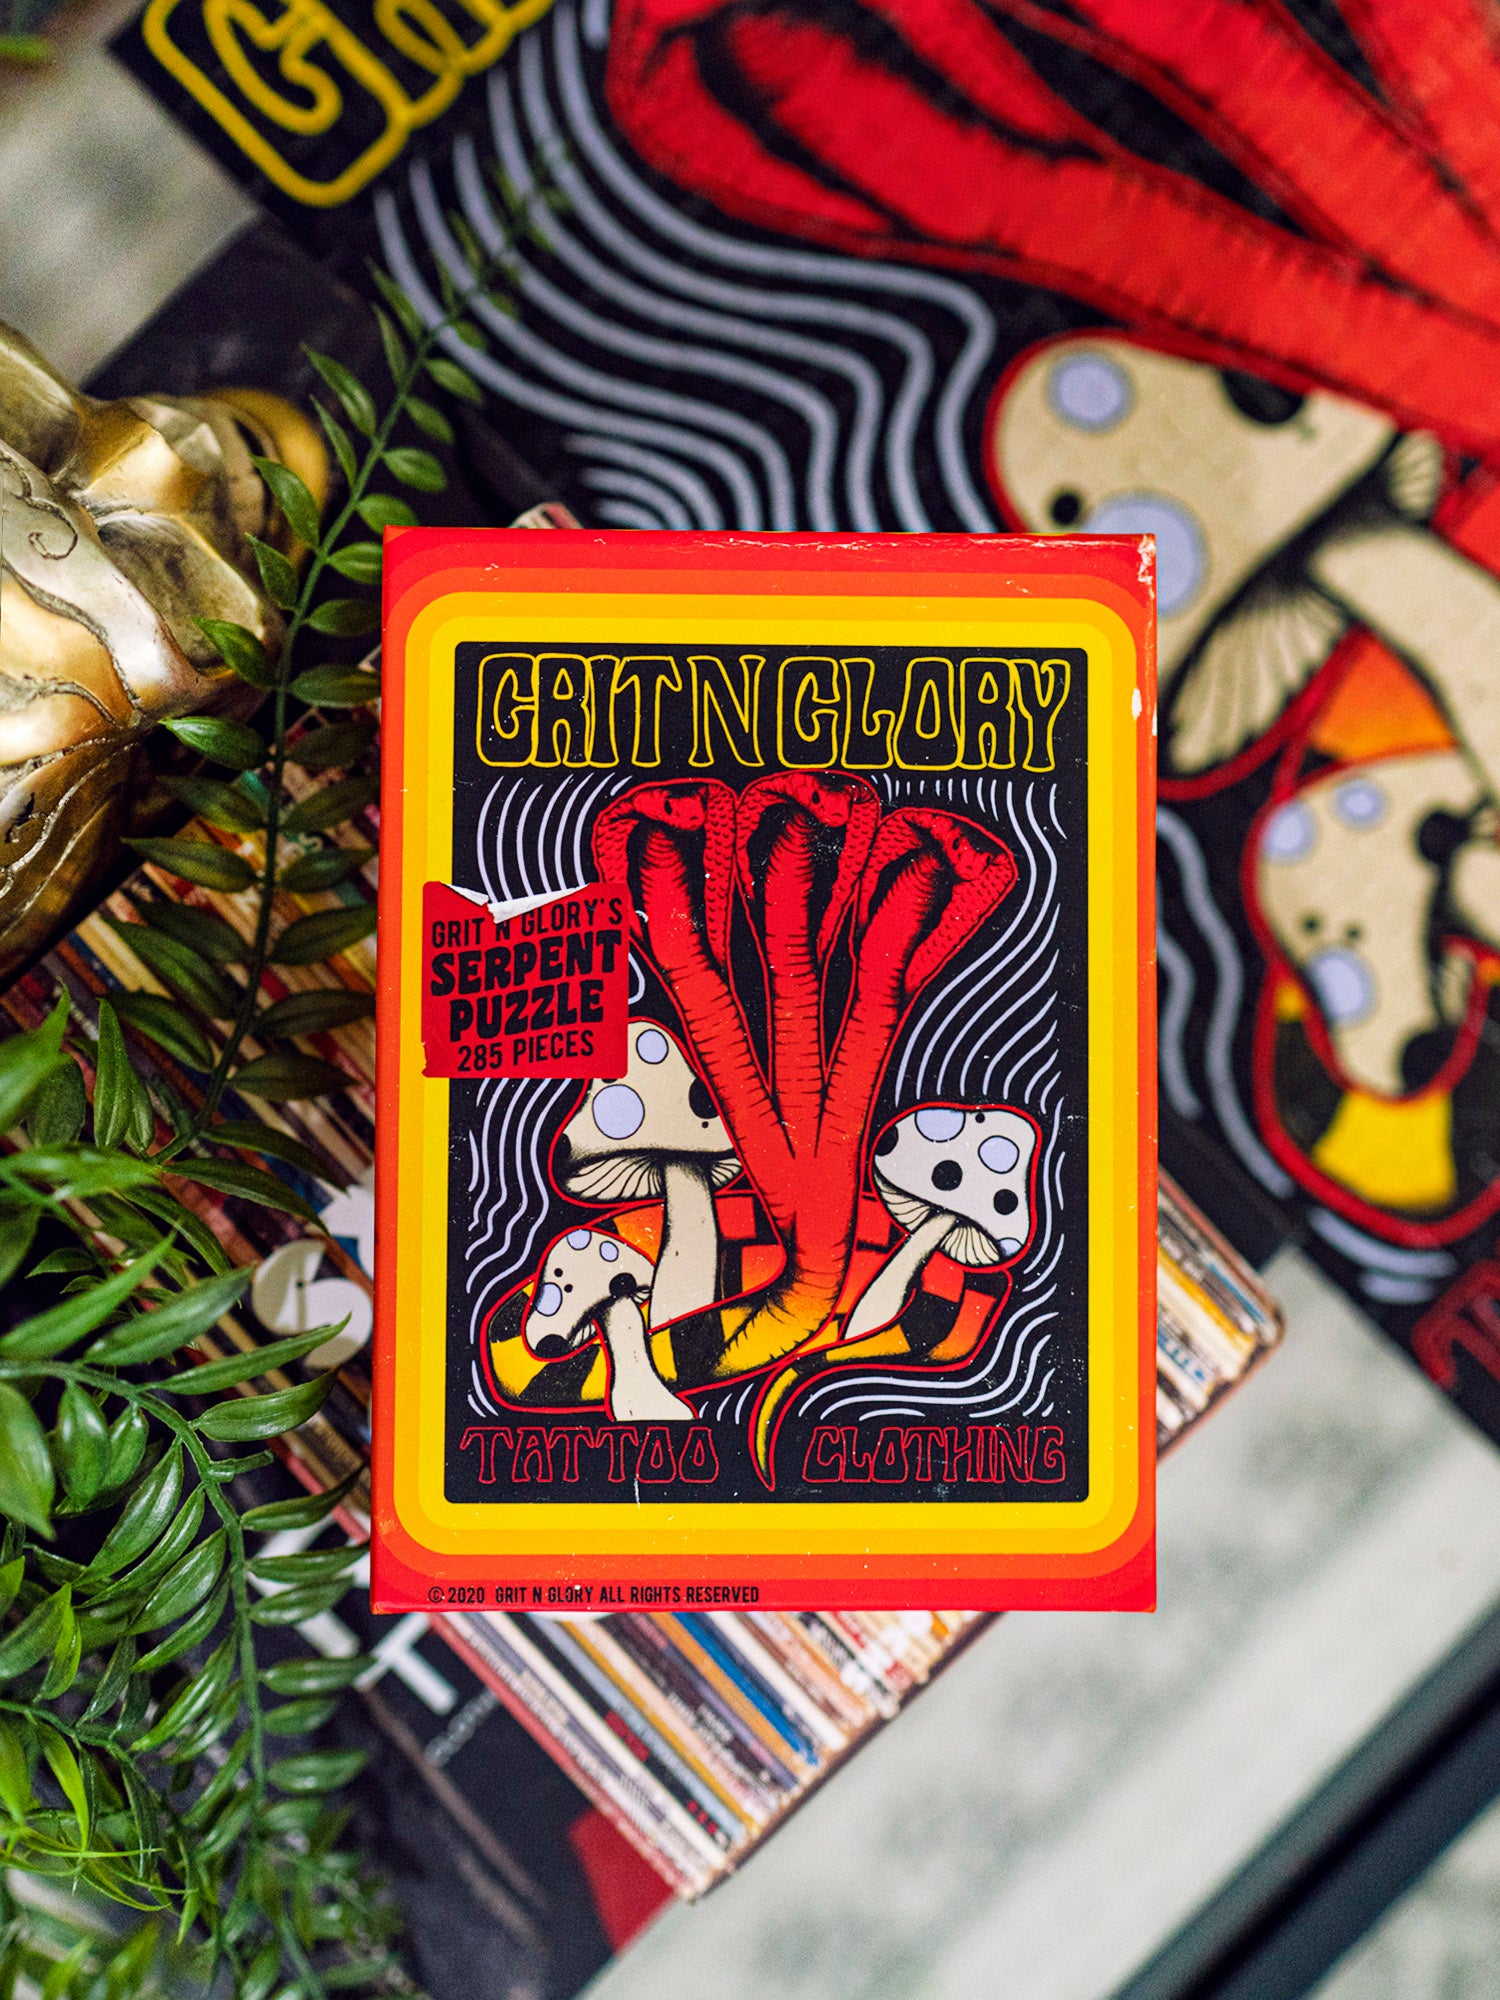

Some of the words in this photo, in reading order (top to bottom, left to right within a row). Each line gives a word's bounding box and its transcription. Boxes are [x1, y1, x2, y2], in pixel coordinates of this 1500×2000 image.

[475, 652, 683, 769] GRIT
[686, 654, 766, 768] N
[776, 655, 1071, 773] GLORY
[431, 917, 485, 948] GRIT
[495, 917, 510, 940] N
[521, 897, 623, 936] GLORY'S
[430, 929, 622, 996] SERPENT
[450, 979, 604, 1042] PUZZLE
[457, 1042, 503, 1072] 285
[513, 1029, 594, 1066] PIECES
[459, 1426, 720, 1484] TATTOO
[801, 1425, 1066, 1483] CLOTHING
[495, 1585, 528, 1604] GRIT
[532, 1585, 543, 1604] N
[547, 1585, 594, 1604] GLORY
[599, 1585, 625, 1604] ALL
[630, 1585, 681, 1604] RIGHTS
[686, 1585, 760, 1604] RESERVED
